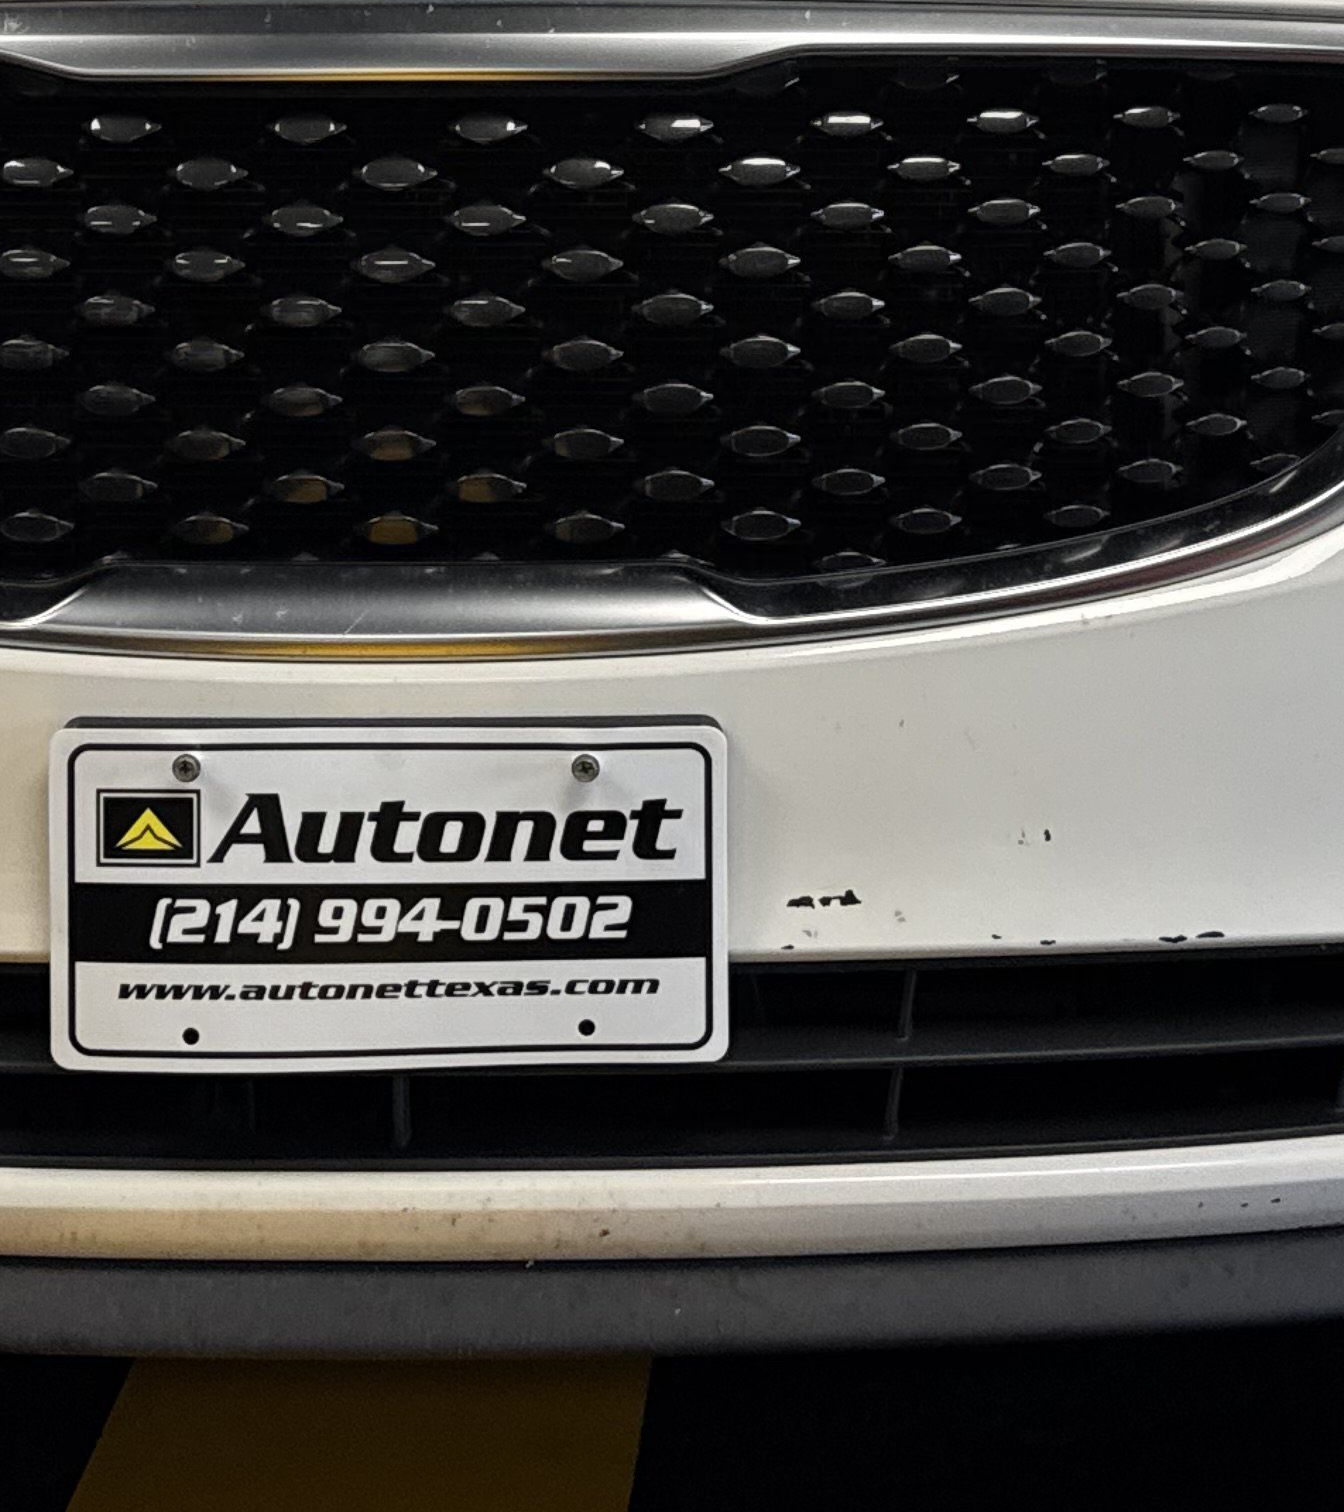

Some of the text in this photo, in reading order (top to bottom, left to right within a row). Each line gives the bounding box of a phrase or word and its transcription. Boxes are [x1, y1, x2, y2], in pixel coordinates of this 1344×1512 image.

[206, 792, 684, 864] Autonet
[149, 895, 633, 951] (214) 994-0502
[117, 976, 661, 1002] www.autonettexas.com
